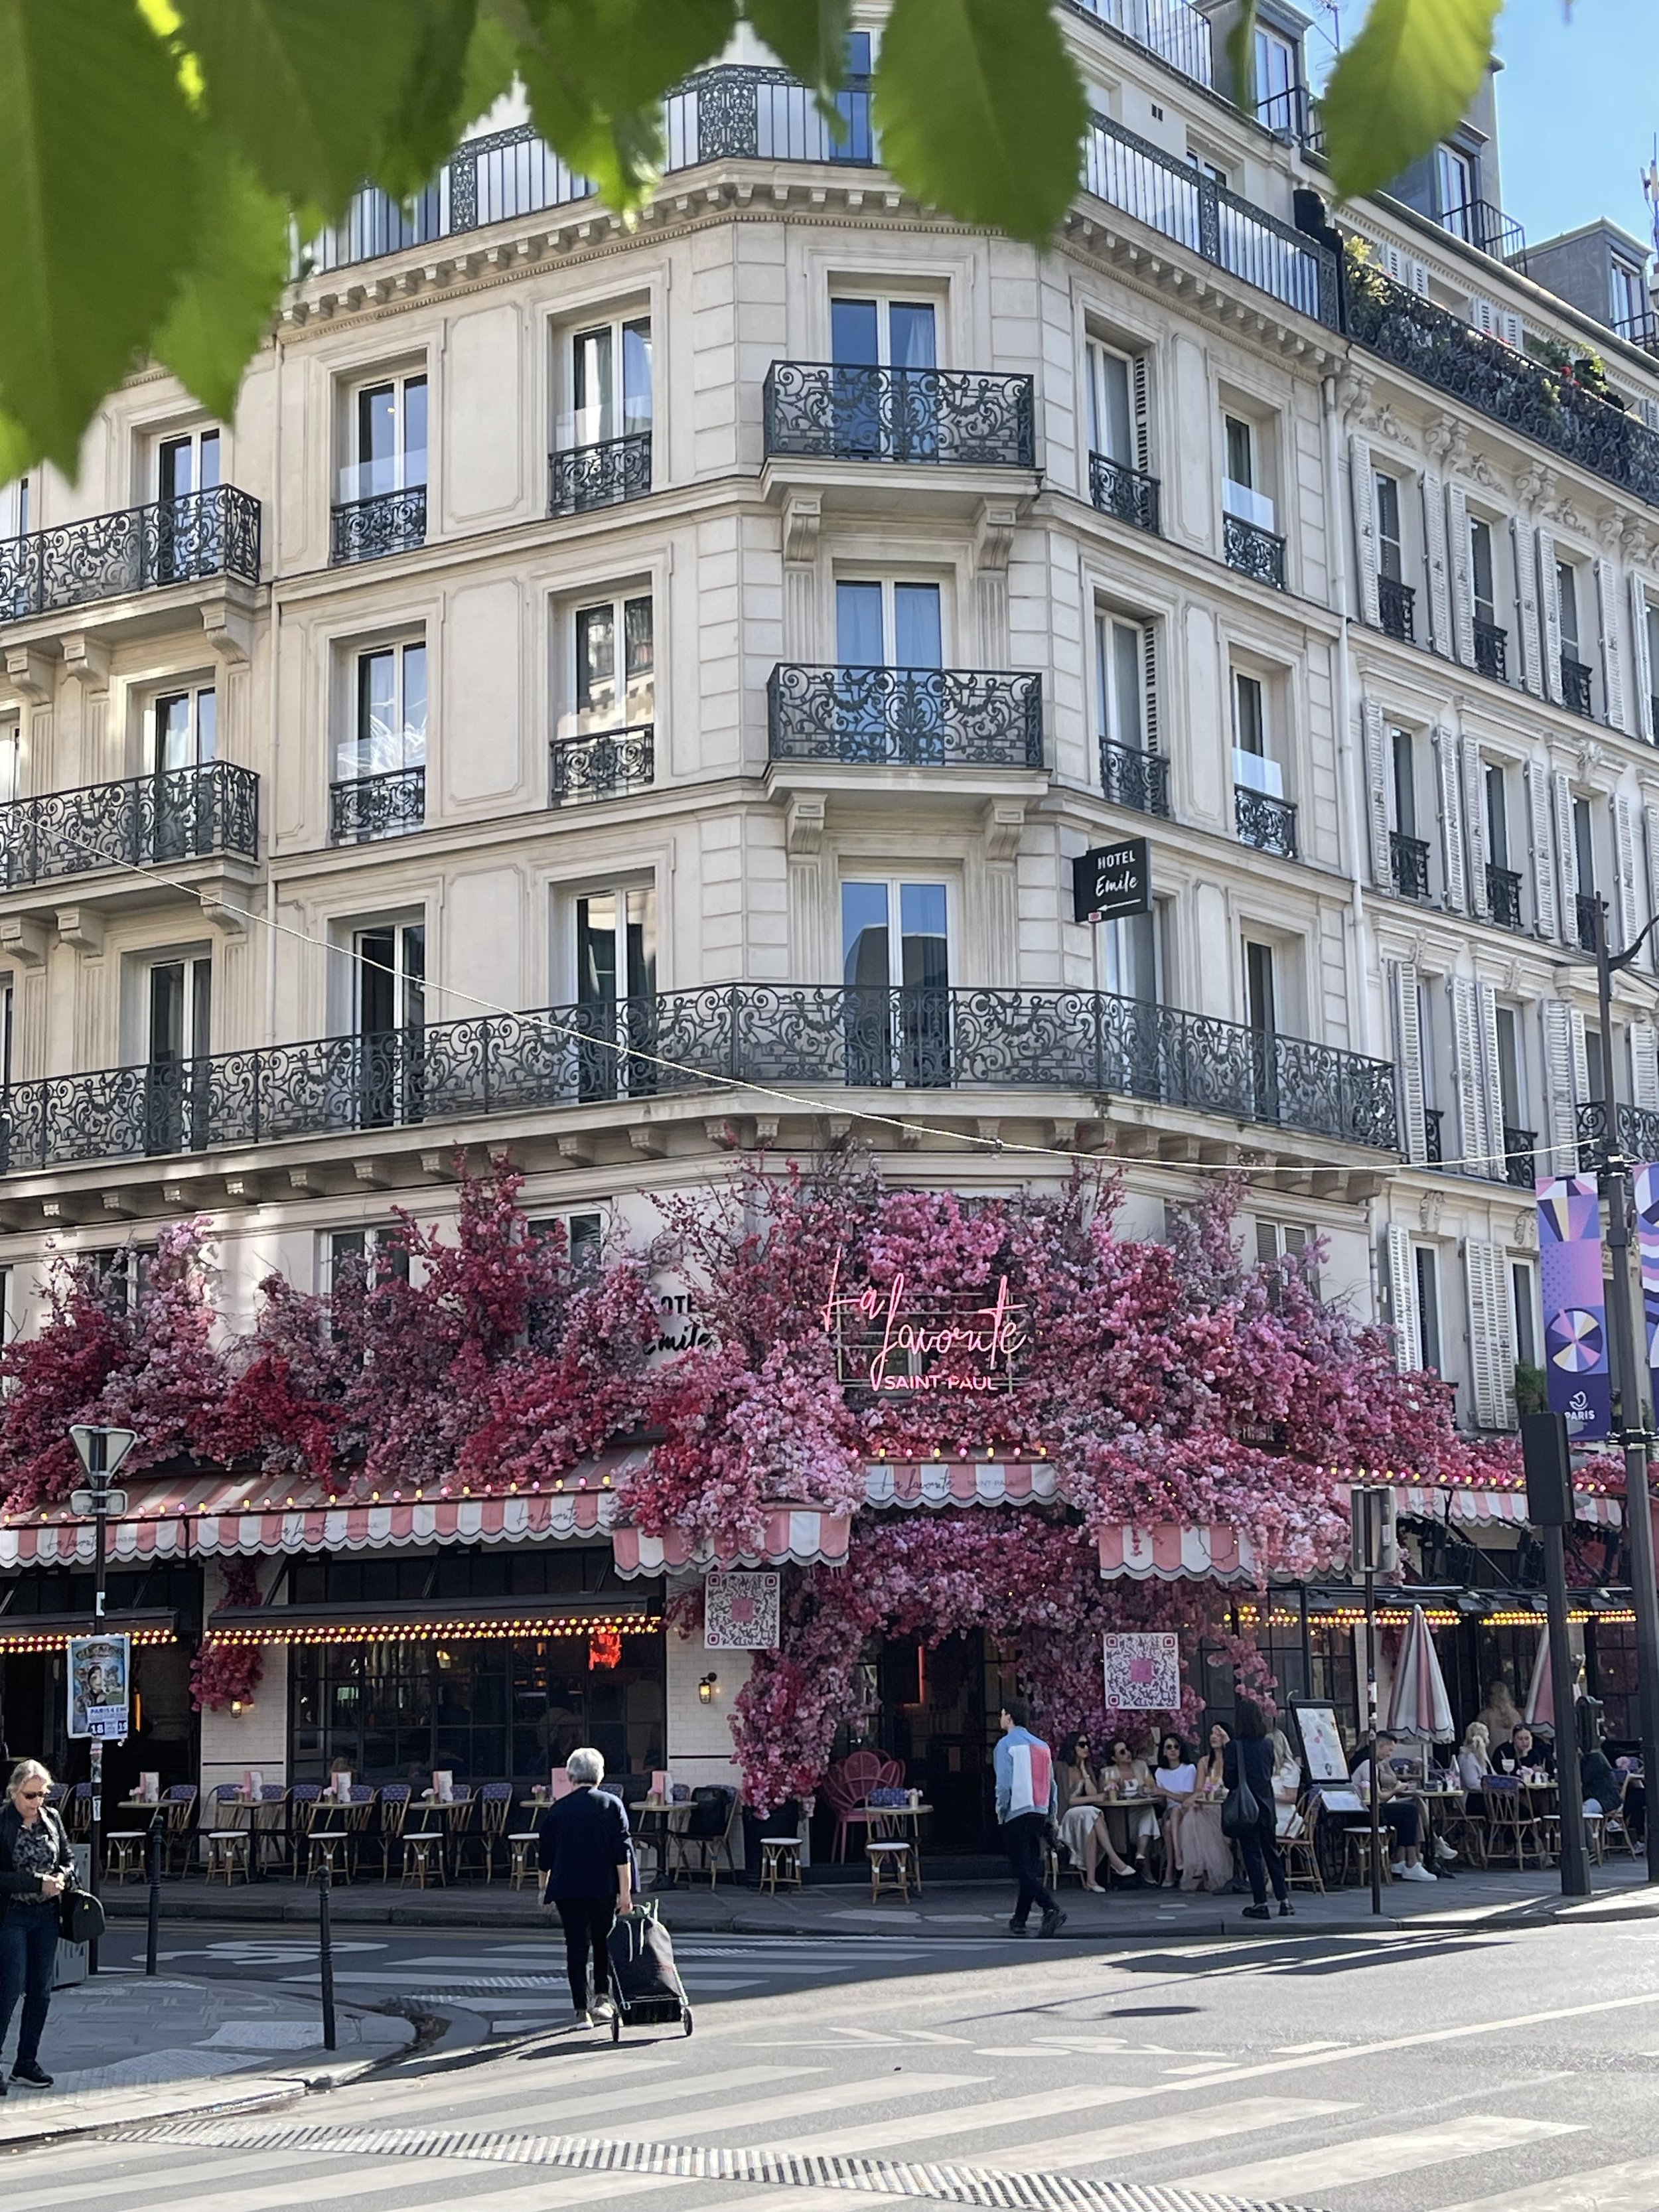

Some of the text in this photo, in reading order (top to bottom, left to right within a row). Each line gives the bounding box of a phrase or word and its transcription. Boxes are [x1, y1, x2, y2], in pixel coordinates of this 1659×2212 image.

[1097, 850, 1135, 869] HOTEL
[1096, 871, 1138, 897] Emile
[821, 1246, 886, 1332] La
[870, 1273, 1028, 1392] favorite
[1564, 1410, 1595, 1420] PARIS
[63, 1526, 97, 1556] favorit
